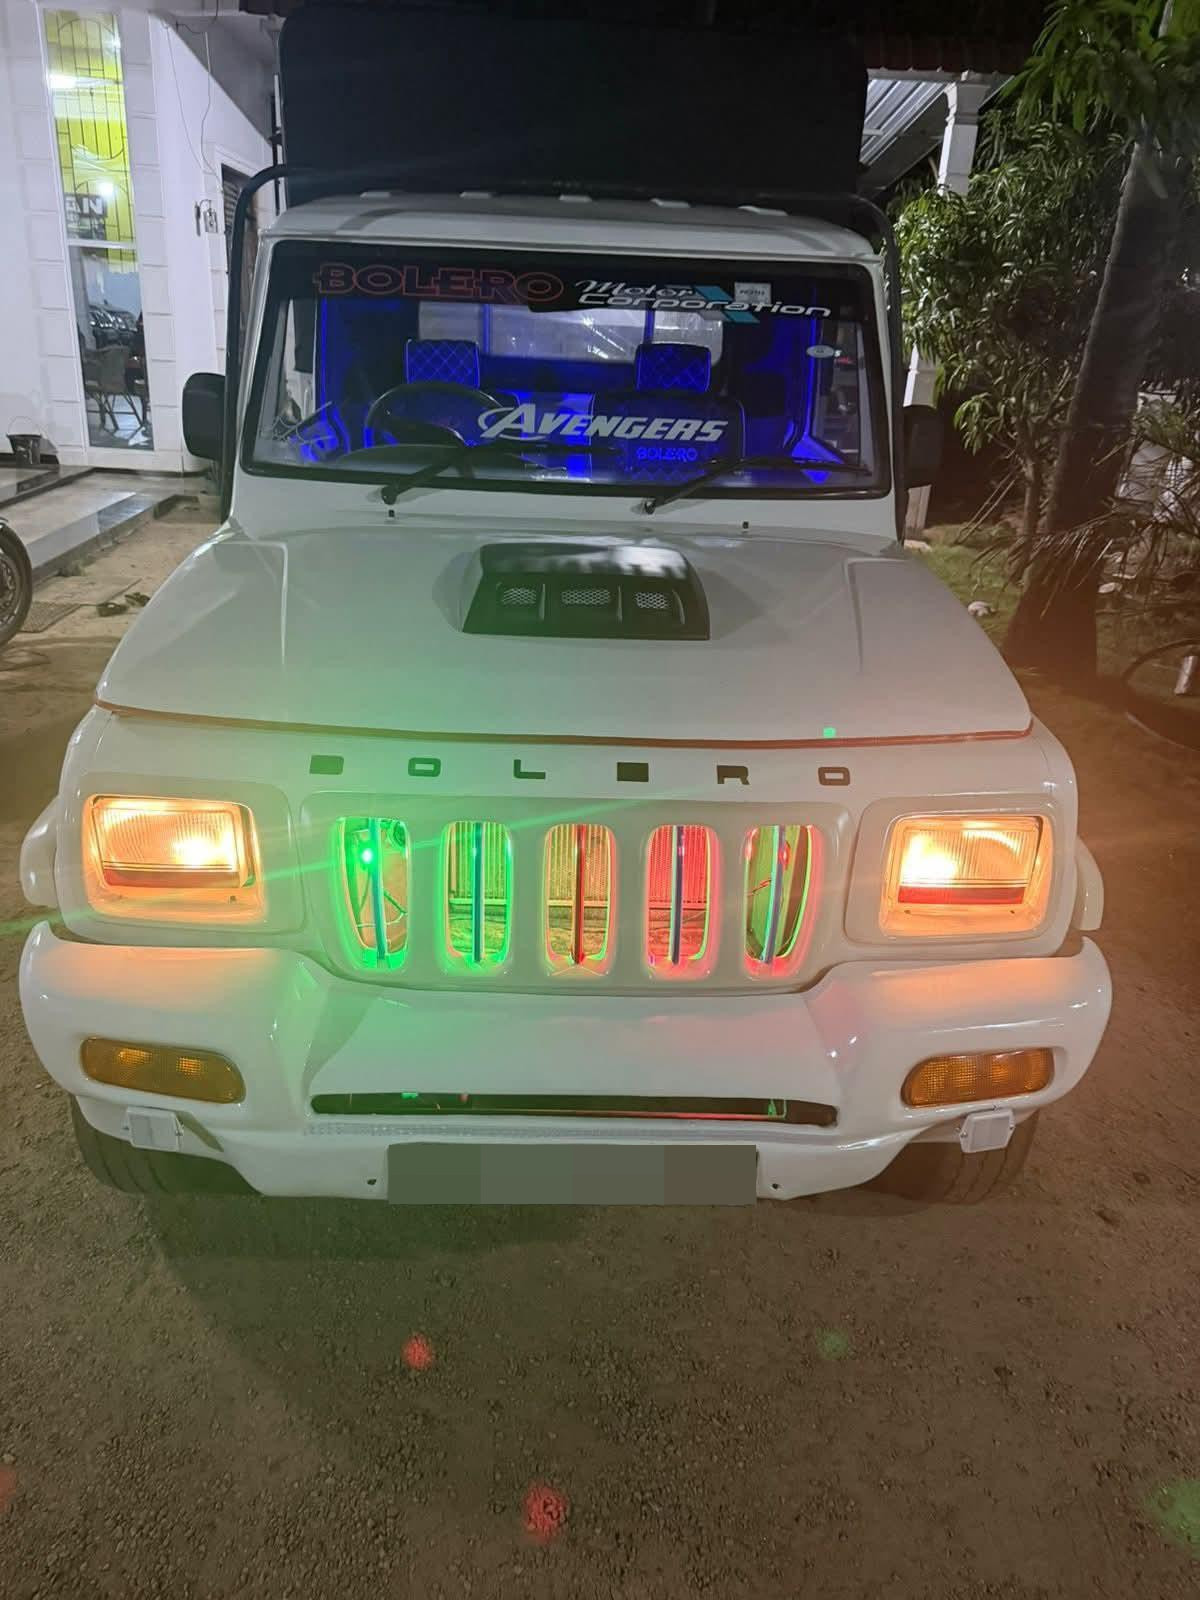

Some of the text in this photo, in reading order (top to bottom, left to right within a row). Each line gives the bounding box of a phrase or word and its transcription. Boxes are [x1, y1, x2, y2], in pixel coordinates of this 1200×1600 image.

[313, 263, 564, 304] BOLERO
[575, 279, 694, 297] Motor
[477, 403, 729, 442] AVENGERS
[636, 447, 698, 462] BOLERO
[309, 754, 851, 786] OLRO
